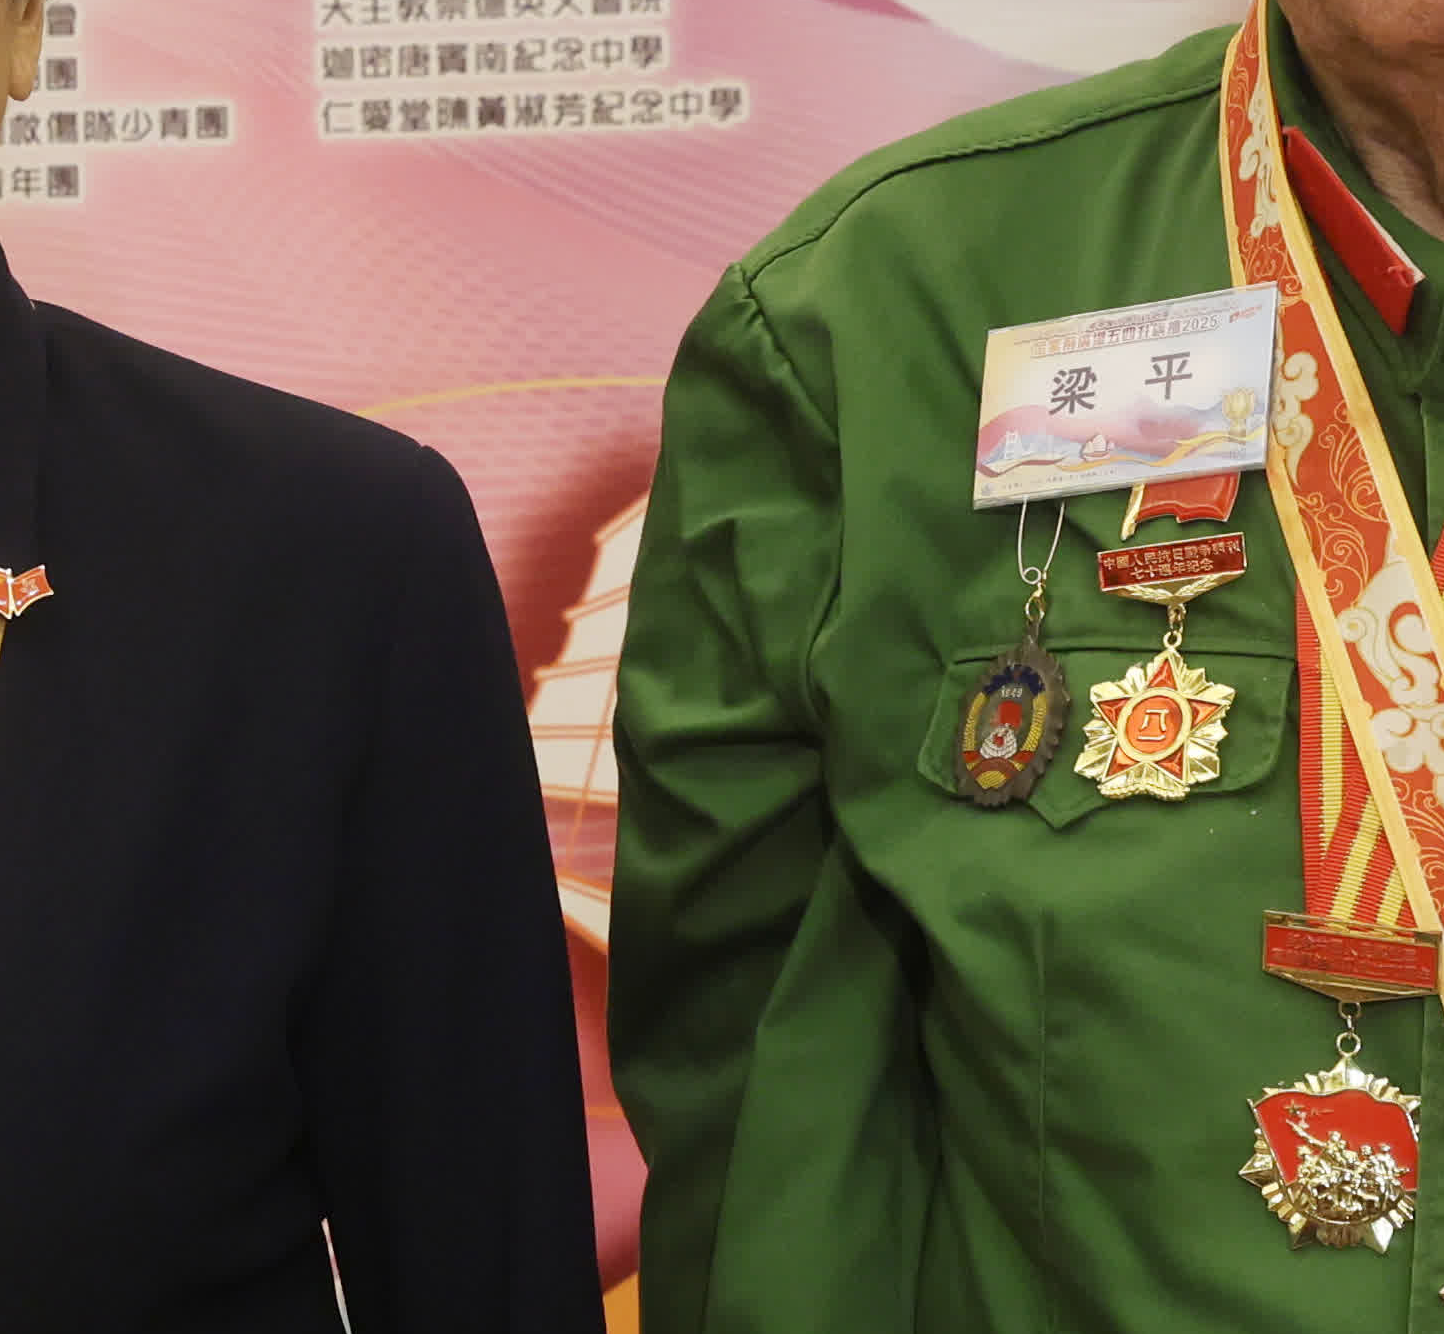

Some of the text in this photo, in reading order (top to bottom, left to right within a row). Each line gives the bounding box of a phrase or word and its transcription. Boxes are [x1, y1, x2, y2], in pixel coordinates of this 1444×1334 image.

[0, 105, 229, 146] 救傷隊少青團
[1048, 351, 1193, 416] 梁平
